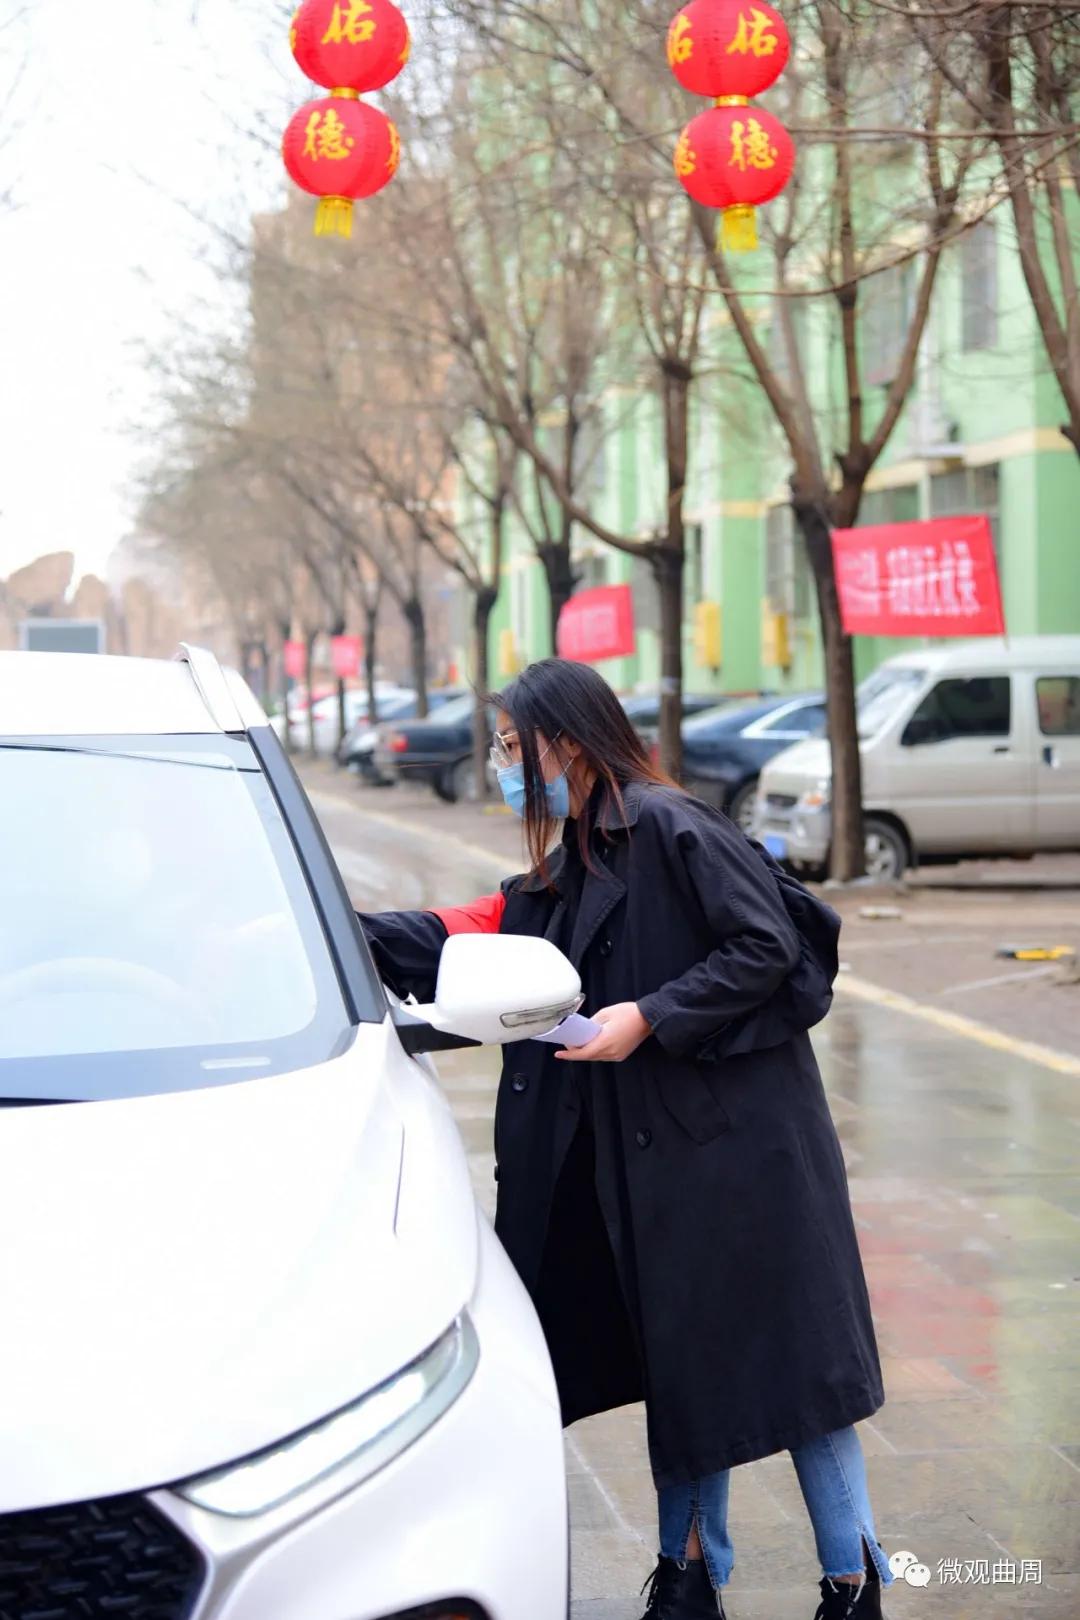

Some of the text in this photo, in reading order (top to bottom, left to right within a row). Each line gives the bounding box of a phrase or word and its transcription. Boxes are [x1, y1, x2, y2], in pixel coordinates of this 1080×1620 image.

[321, 0, 377, 45] 佑
[726, 7, 778, 57] 佑
[303, 108, 355, 162] 德
[728, 117, 778, 172] 德
